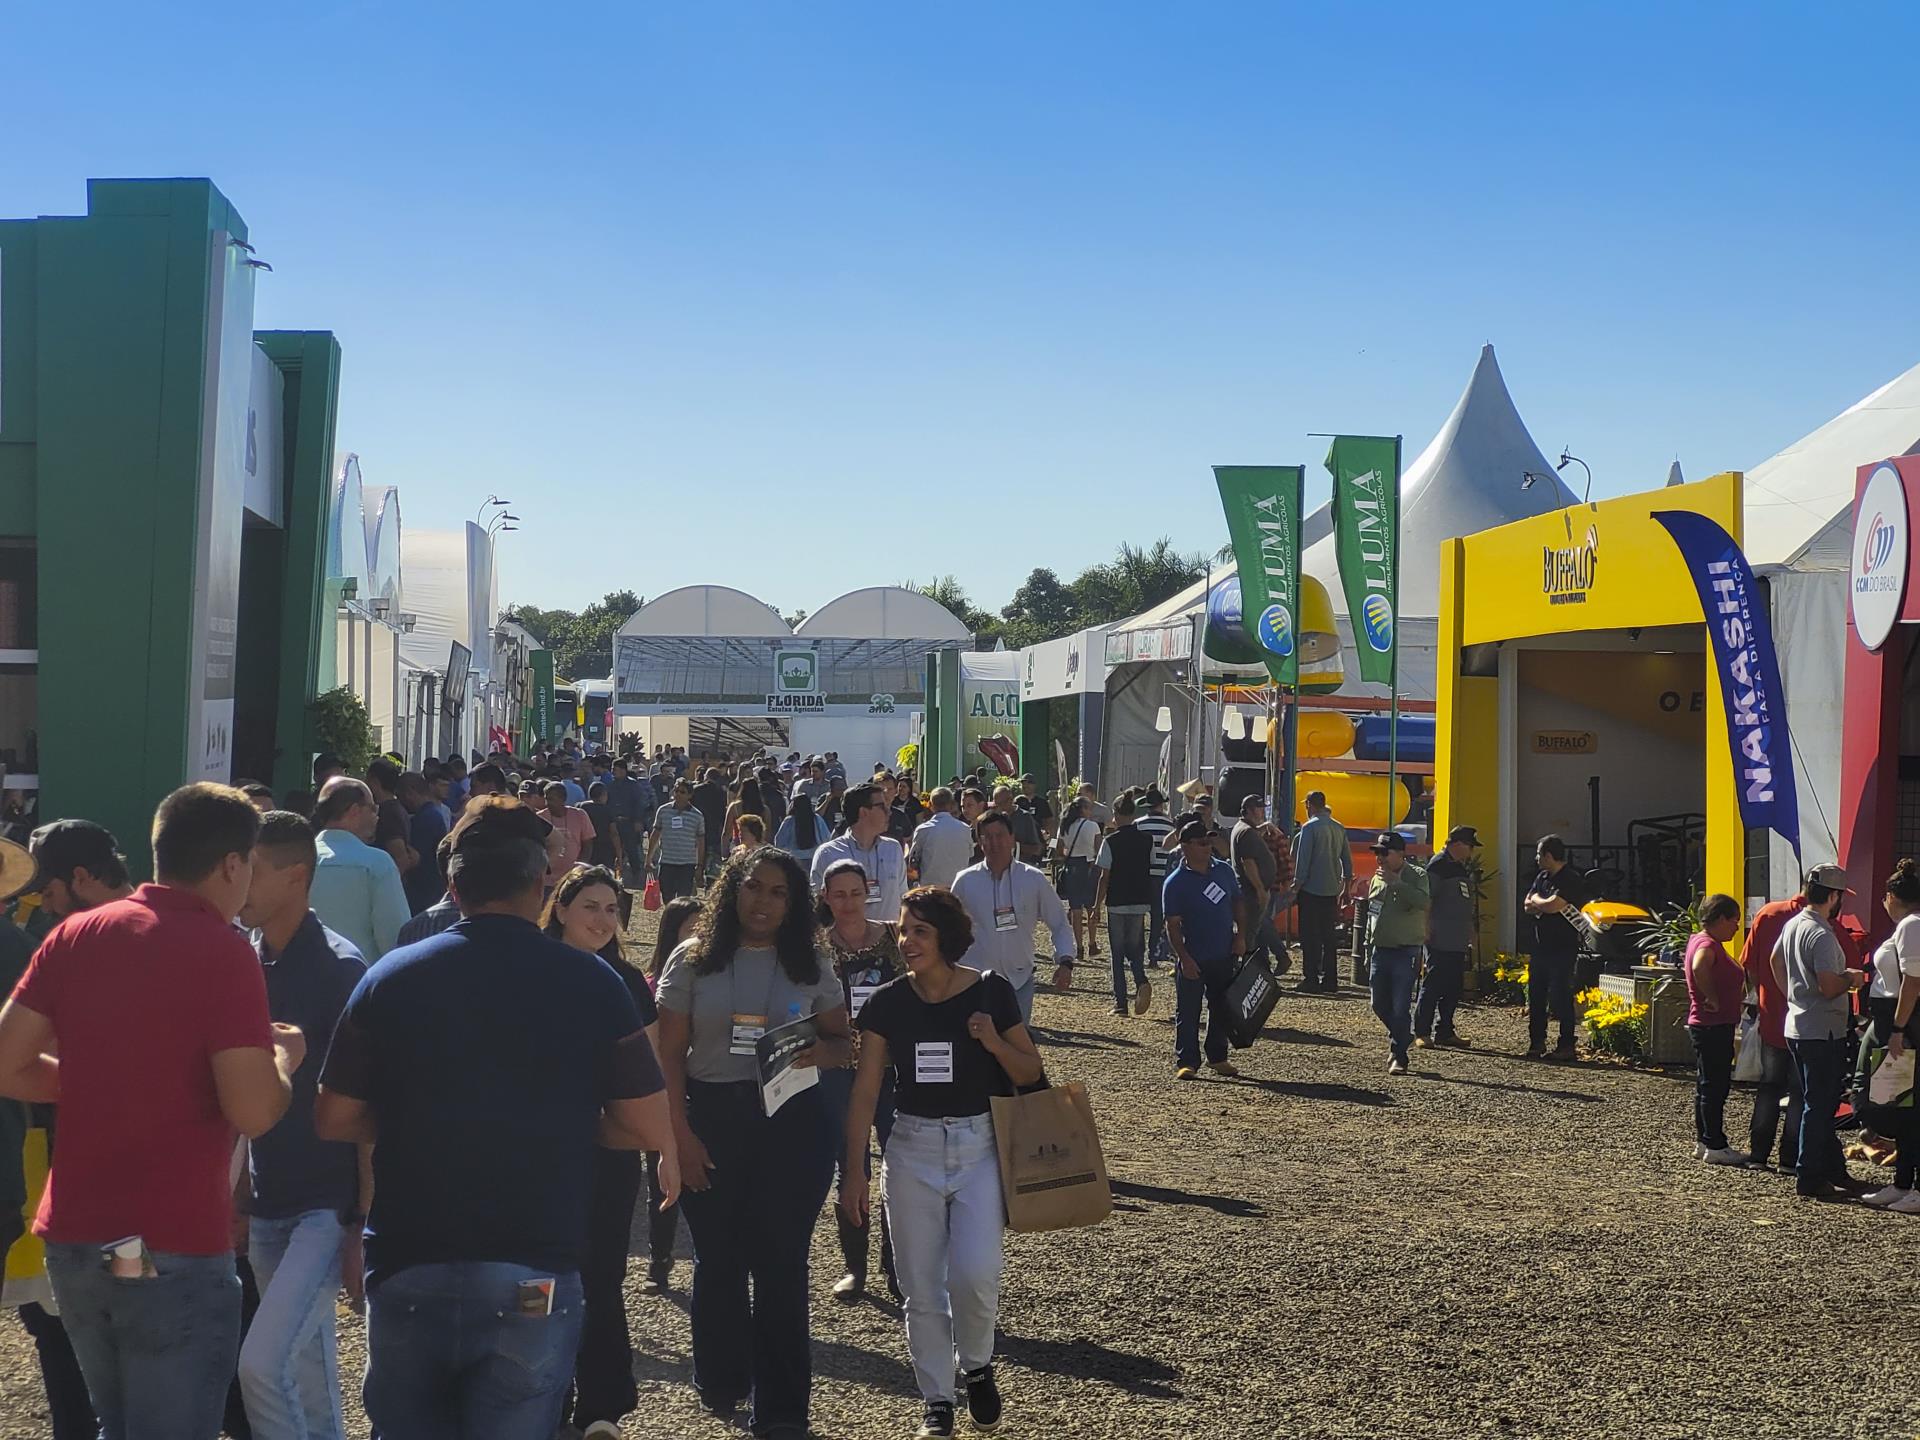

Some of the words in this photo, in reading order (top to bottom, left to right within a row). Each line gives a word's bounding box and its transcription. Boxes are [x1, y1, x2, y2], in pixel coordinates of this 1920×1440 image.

[1253, 494, 1288, 603] LUMA
[1350, 468, 1387, 592] LUMA
[1383, 526, 1392, 594] IMPLEMENTOS
[1285, 545, 1293, 605] IMPLEMENTOS
[1543, 546, 1595, 592] BUFFALO
[1856, 576, 1868, 592] CCM
[1869, 576, 1879, 592] DO
[1879, 575, 1897, 592] BRASIL
[1732, 558, 1758, 662] DIFERENÇA
[1707, 561, 1774, 802] NAKASHI
[1754, 670, 1762, 681] A
[1757, 689, 1770, 723] FAZ
[1538, 735, 1587, 748] BUFFALO
